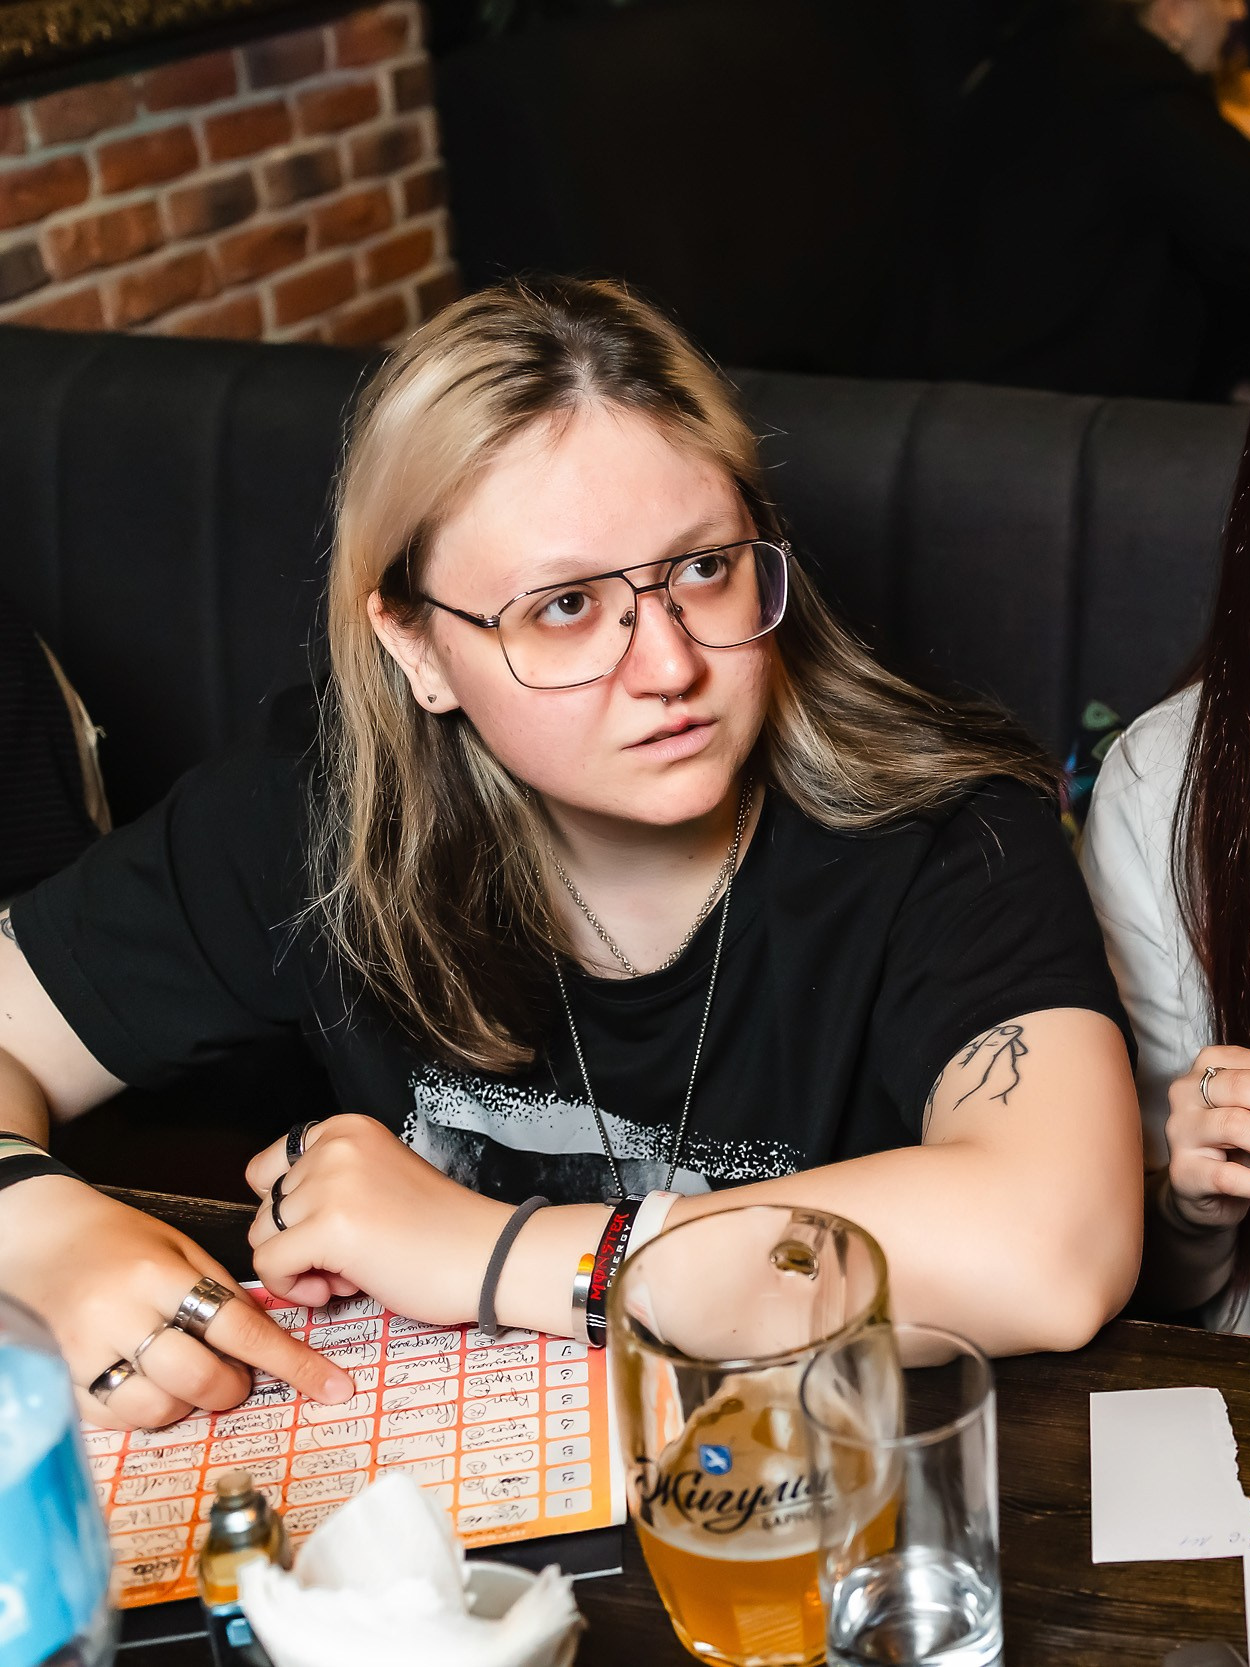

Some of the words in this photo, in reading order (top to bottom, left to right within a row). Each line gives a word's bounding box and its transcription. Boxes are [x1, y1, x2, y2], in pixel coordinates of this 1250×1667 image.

[590, 1213, 630, 1301] MONSTER
[606, 1223, 632, 1288] ENERGY
[561, 1345, 572, 1357] 7
[560, 1368, 574, 1381] 6
[561, 1394, 574, 1405] 5
[560, 1418, 574, 1430] 4
[561, 1445, 574, 1457] 3
